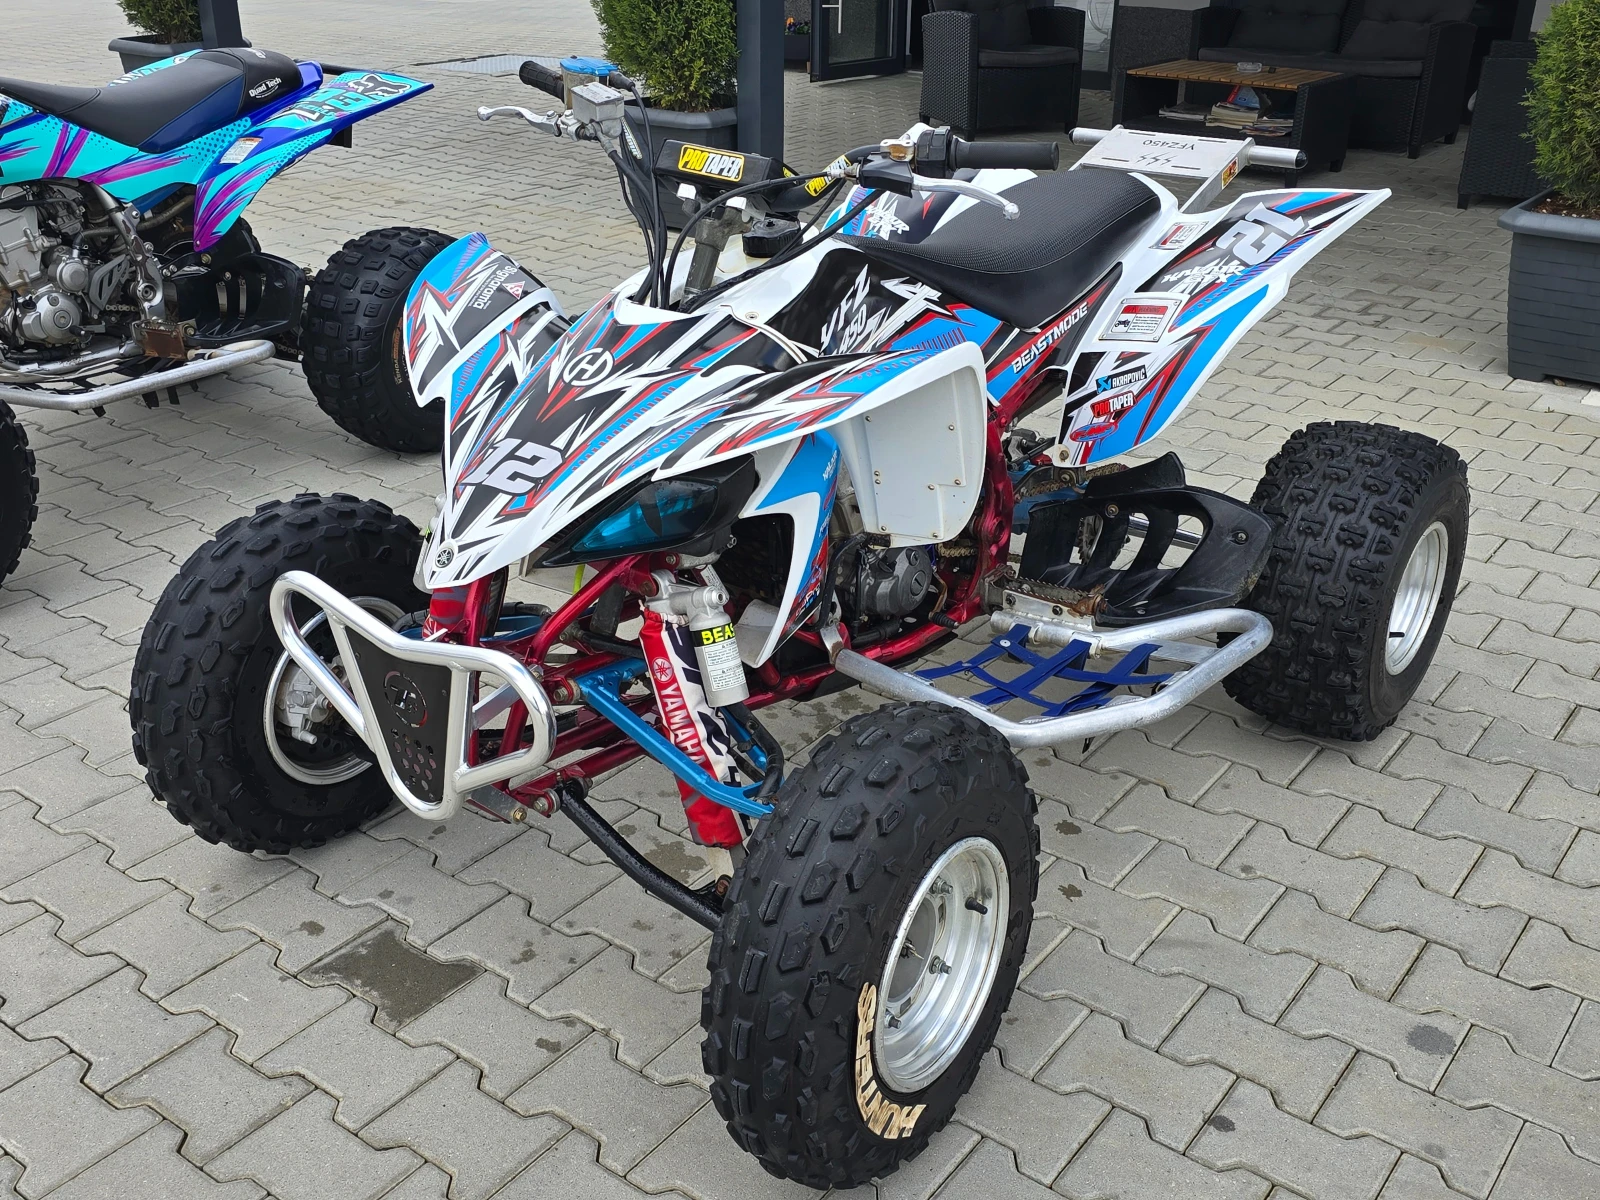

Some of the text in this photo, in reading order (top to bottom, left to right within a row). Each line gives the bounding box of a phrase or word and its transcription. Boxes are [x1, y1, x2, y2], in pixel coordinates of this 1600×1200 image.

[249, 84, 267, 98] Quad
[267, 77, 282, 90] Tech
[679, 148, 742, 179] PROTAPER
[1142, 139, 1195, 151] YFZ450
[472, 265, 518, 310] Signarama
[1011, 301, 1088, 374] BEASTMODE
[1094, 392, 1135, 416] PROTAPER
[460, 437, 563, 494] 12
[855, 981, 927, 1140] HUNTERS
